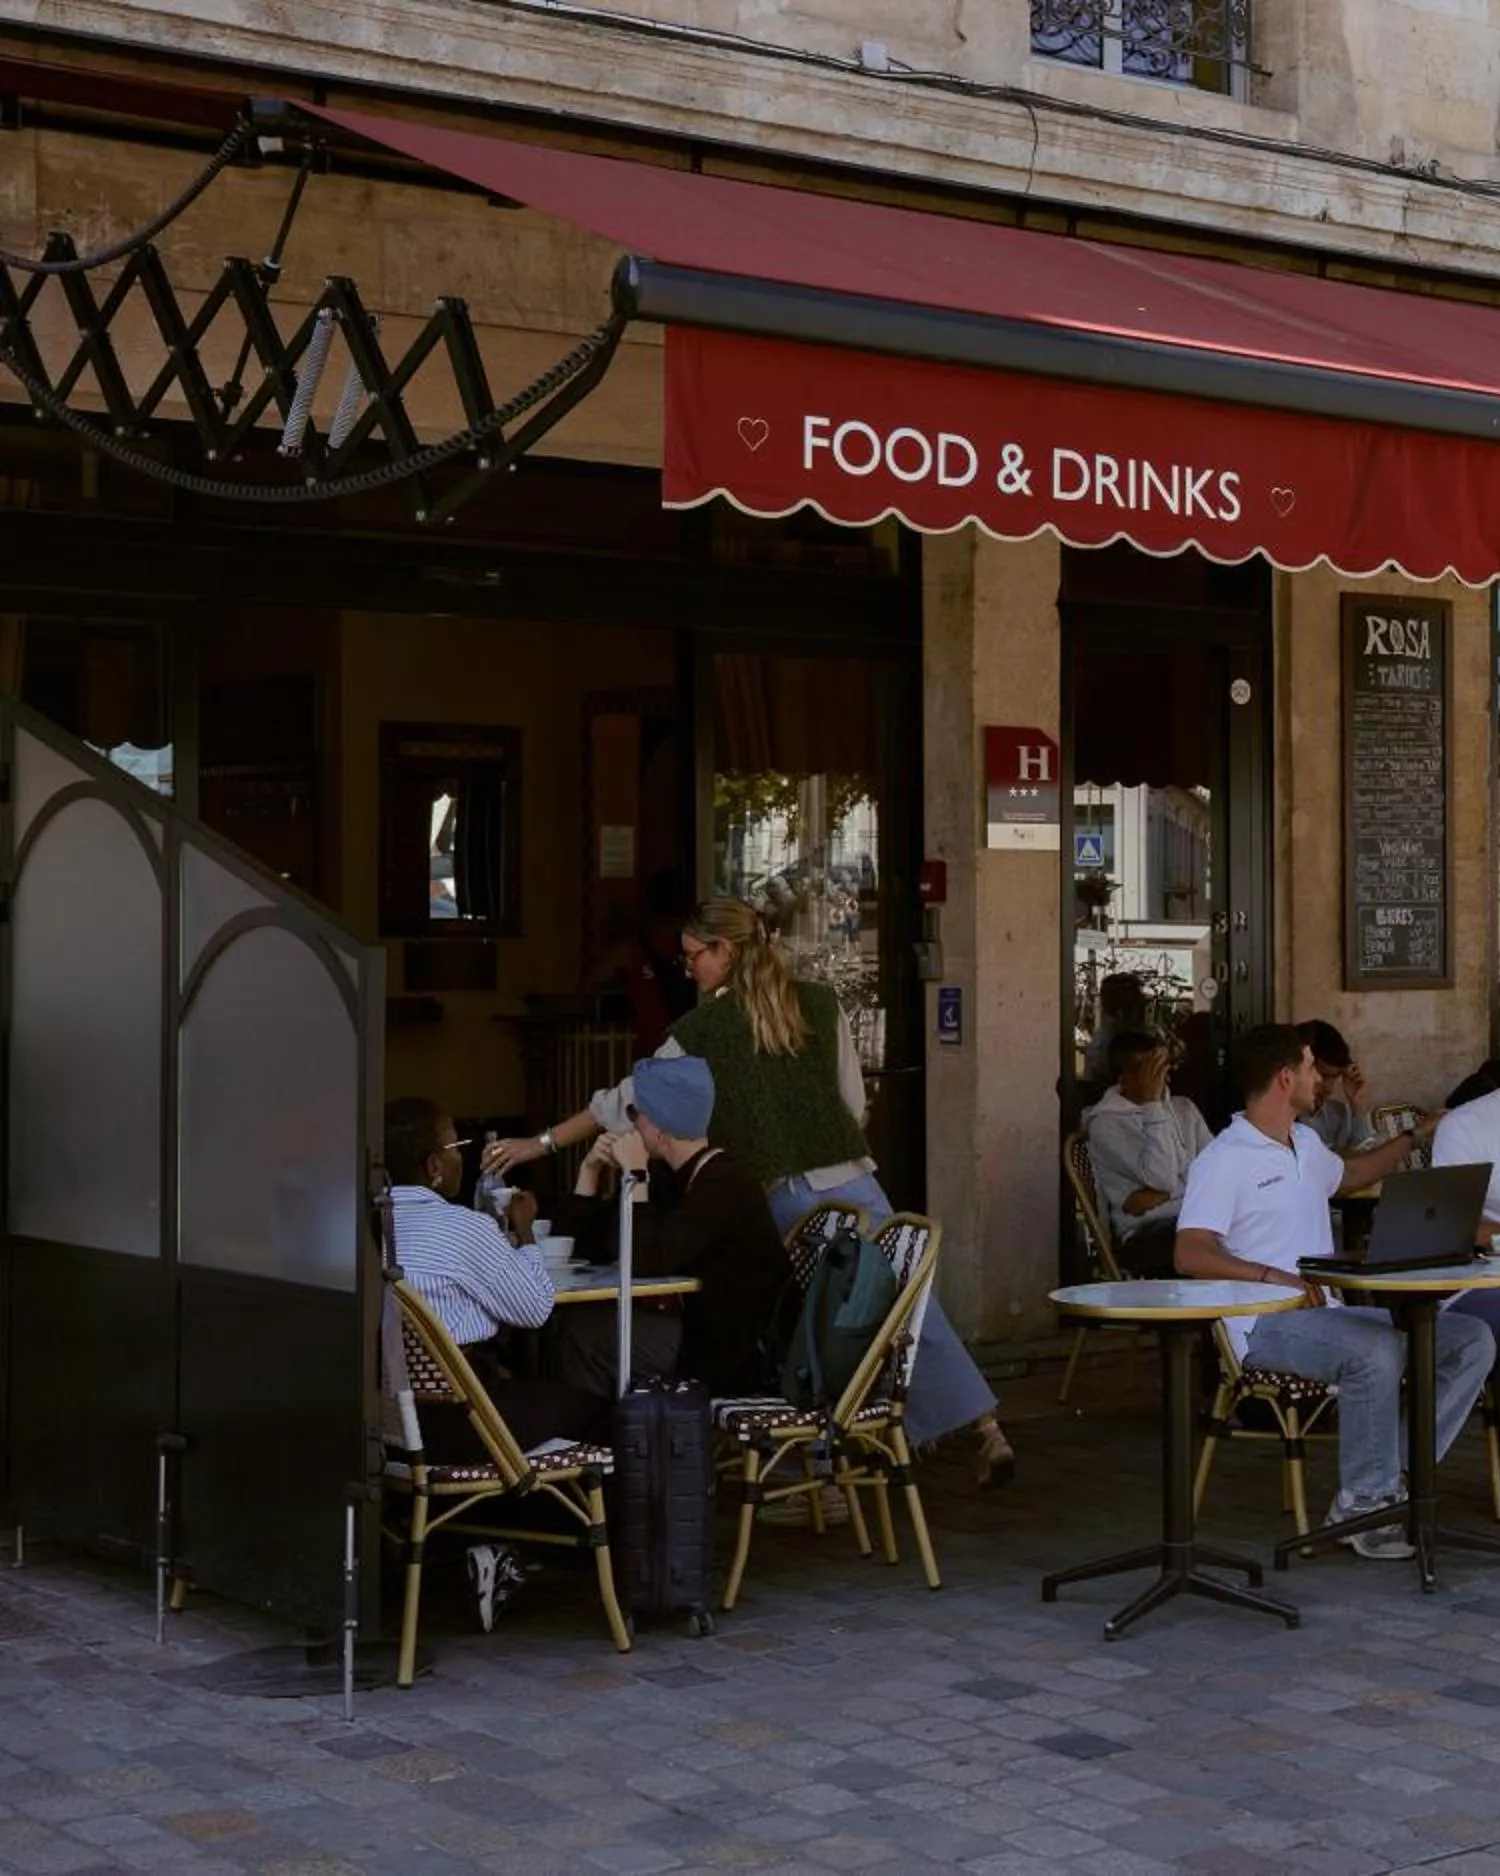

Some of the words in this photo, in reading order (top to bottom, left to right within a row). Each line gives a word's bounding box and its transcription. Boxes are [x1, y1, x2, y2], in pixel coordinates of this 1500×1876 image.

[803, 414, 978, 487] FOOD
[996, 442, 1033, 497] &
[1052, 447, 1241, 522] DRINKS
[1363, 615, 1431, 660] ROSA
[1016, 744, 1052, 781] H
